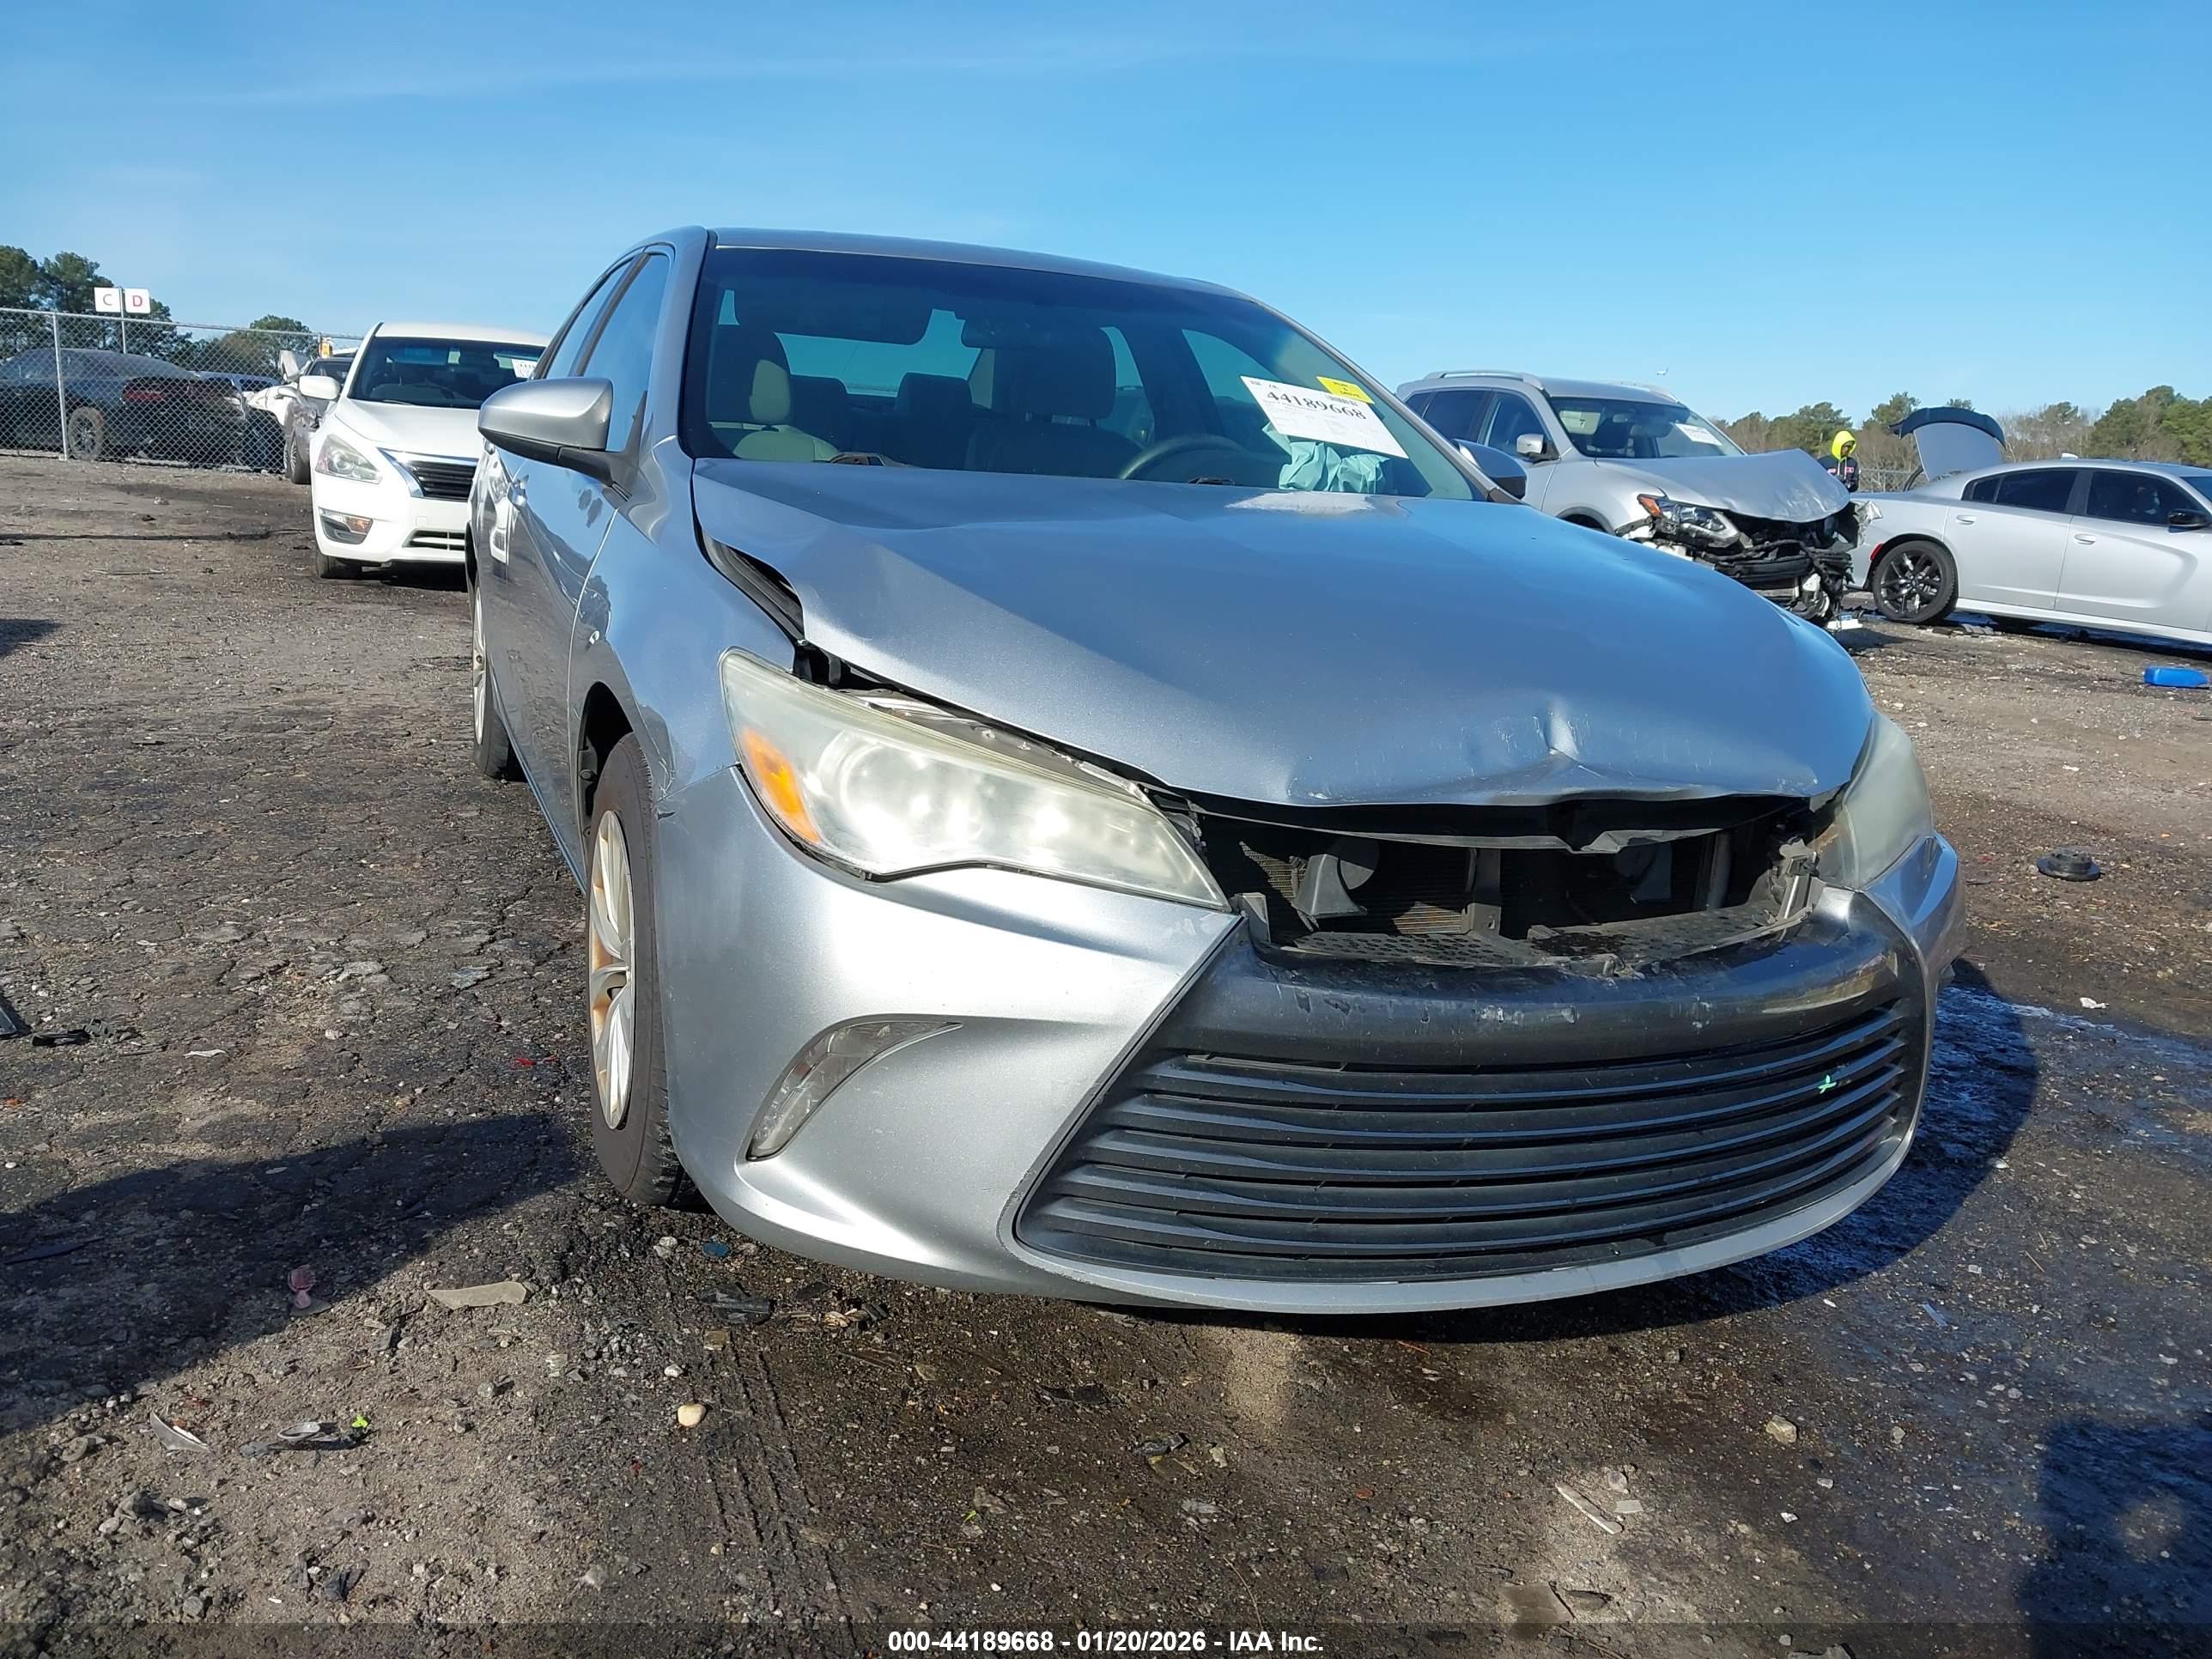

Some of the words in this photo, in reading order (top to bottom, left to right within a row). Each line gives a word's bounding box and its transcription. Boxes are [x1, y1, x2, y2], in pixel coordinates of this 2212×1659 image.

[103, 294, 112, 306] C
[132, 295, 143, 307] D
[1267, 391, 1367, 420] 44189668
